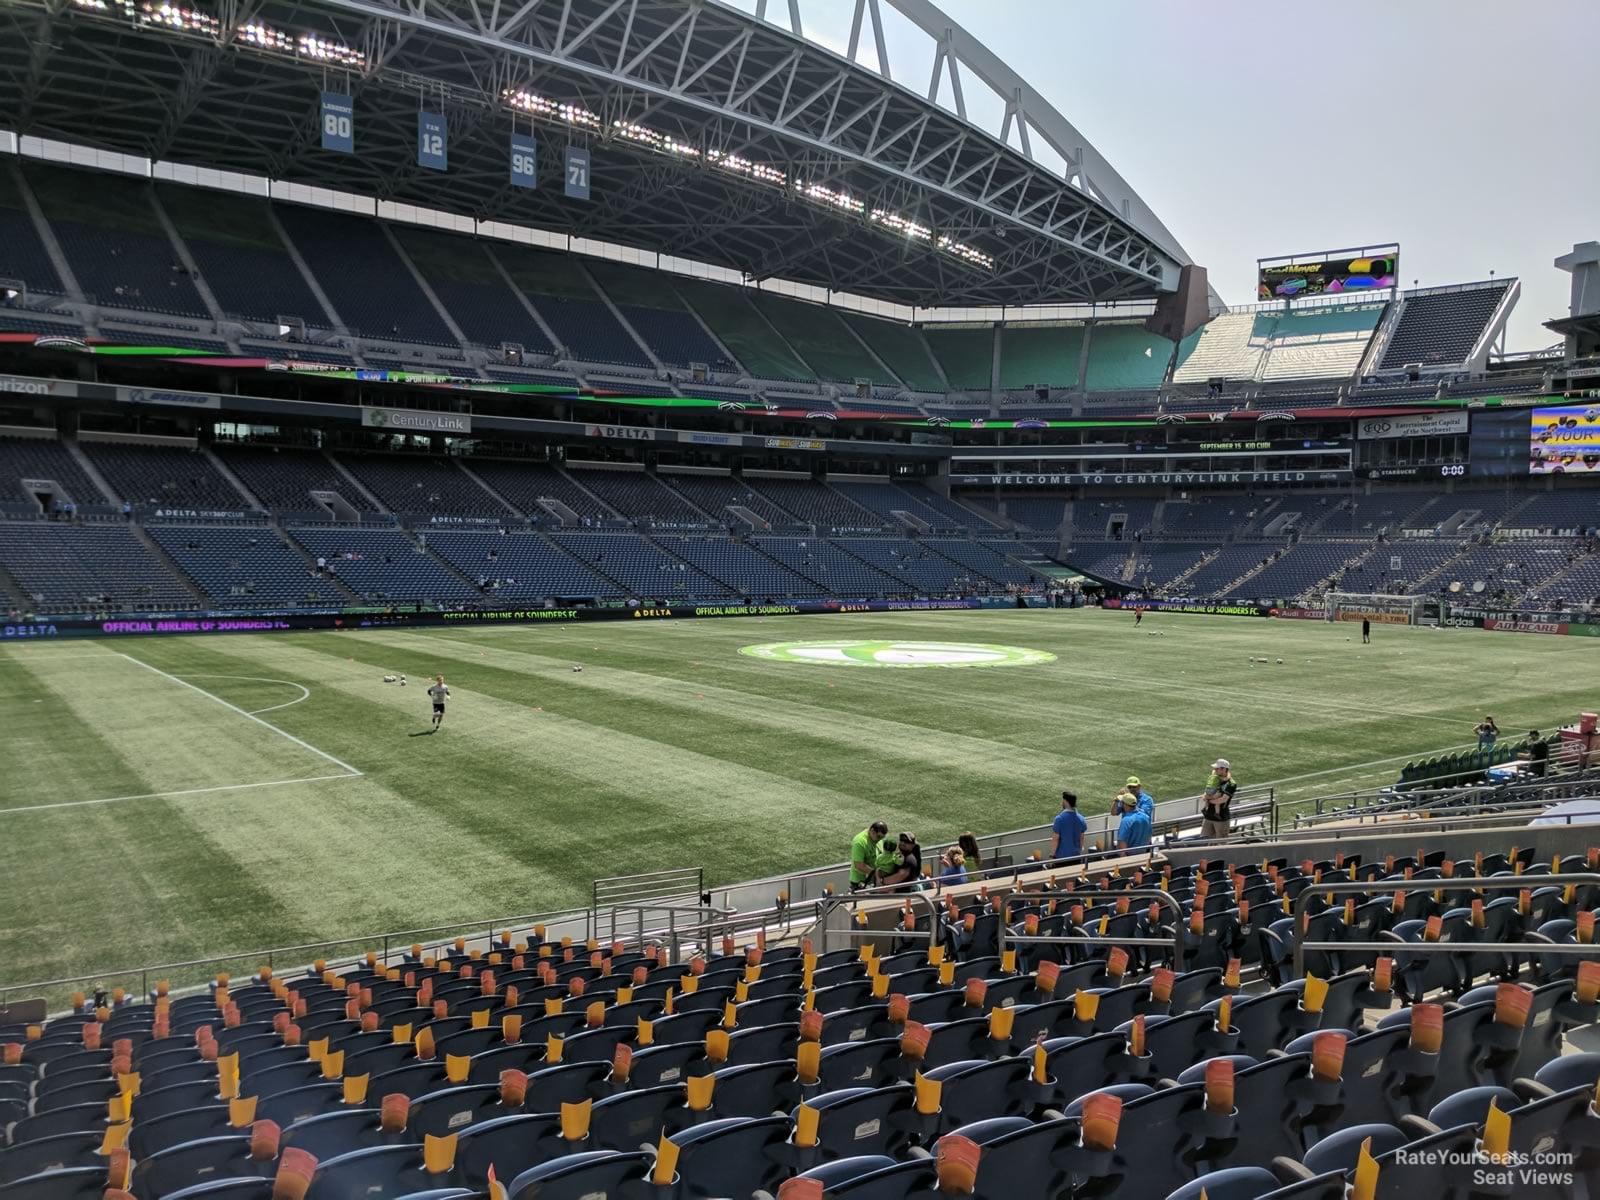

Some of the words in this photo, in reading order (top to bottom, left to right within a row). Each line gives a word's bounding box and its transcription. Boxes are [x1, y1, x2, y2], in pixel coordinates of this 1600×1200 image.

[324, 114, 351, 138] 80
[423, 133, 443, 156] 12
[512, 154, 534, 176] 96
[569, 166, 586, 187] 71
[391, 412, 464, 430] CenturyLink
[1395, 421, 1438, 429] Entertainment
[1438, 418, 1460, 427] Capital
[606, 428, 650, 441] DELTA
[1441, 464, 1464, 477] 0:00
[991, 475, 1071, 485] WELCOME
[1082, 475, 1103, 484] TO
[1114, 473, 1240, 484] CENTURYLINK
[1252, 472, 1306, 482] FIELD
[165, 509, 197, 517] DELTA
[643, 609, 672, 617] DELTA
[695, 607, 724, 617] OFFICIAL
[724, 606, 749, 616] AIRLINE
[749, 606, 758, 615] OF
[758, 605, 791, 615] SOUNDERS
[1157, 603, 1182, 611] OFFICIAL
[1183, 604, 1207, 612] AIRLINE
[1206, 605, 1215, 613] OF
[1215, 606, 1249, 615] SOUNDERS
[1281, 609, 1299, 617] Audi
[4, 624, 58, 636] DELTA
[102, 621, 154, 632] OFFICIAL
[1492, 620, 1557, 634] ADVOCARE
